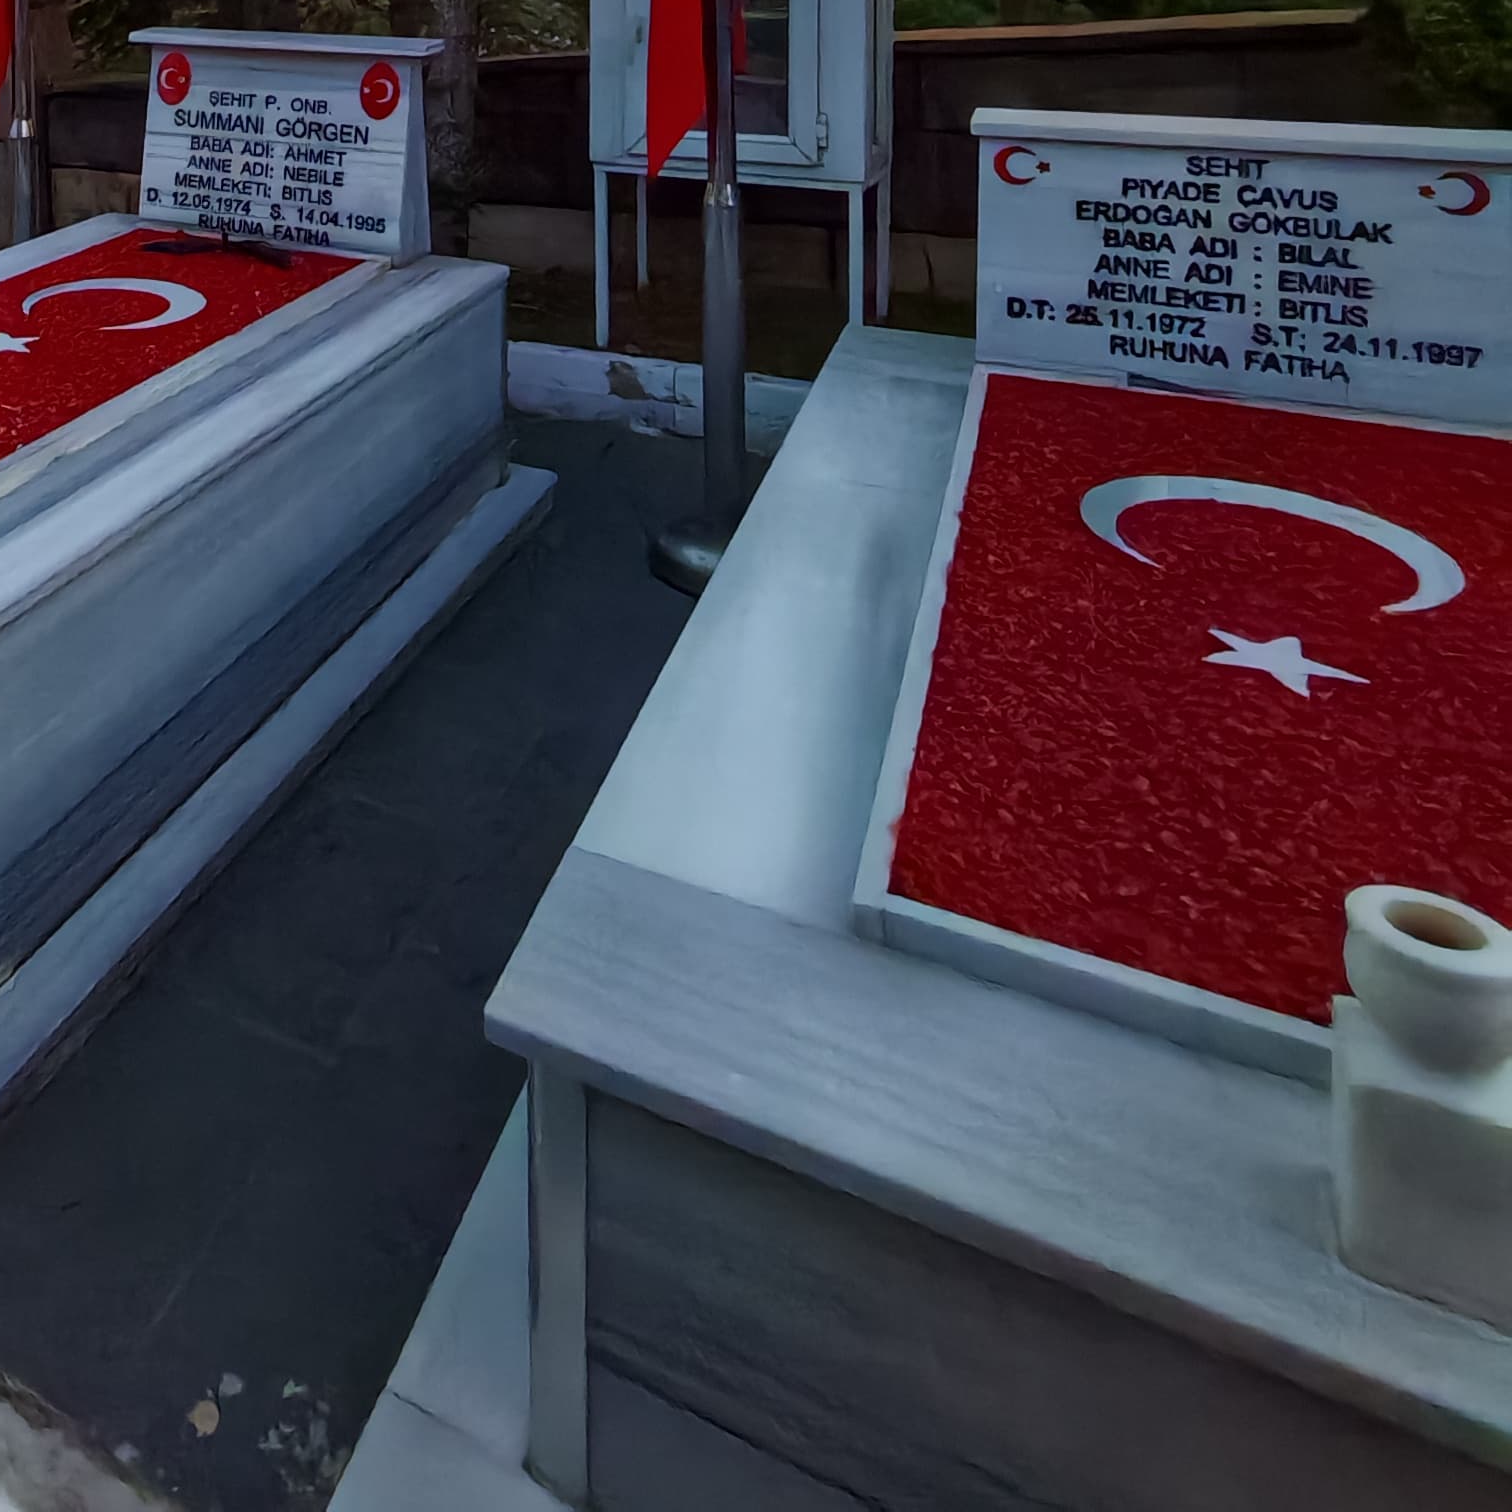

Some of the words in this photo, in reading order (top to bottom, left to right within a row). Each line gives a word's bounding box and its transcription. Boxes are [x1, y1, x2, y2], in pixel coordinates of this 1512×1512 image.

[265, 95, 281, 110] P.
[291, 98, 332, 115] ONB.
[174, 108, 265, 135] SUMMANI
[276, 117, 369, 145] GÖRGEN
[187, 155, 232, 174] ANNE
[240, 161, 274, 179] ADI:
[190, 135, 233, 154] BABA
[240, 140, 274, 159] ADI:
[284, 145, 347, 167] AHMET
[147, 188, 162, 203] D.
[172, 191, 252, 215] 12.05.1974
[297, 206, 386, 233] 14.04.1995
[198, 213, 265, 236] RUHUNA
[1103, 228, 1176, 254] BABA
[1189, 235, 1238, 259] ADI
[1094, 254, 1171, 279] ANNE
[1184, 262, 1233, 286] ADI
[1110, 334, 1228, 369] RUHUNA
